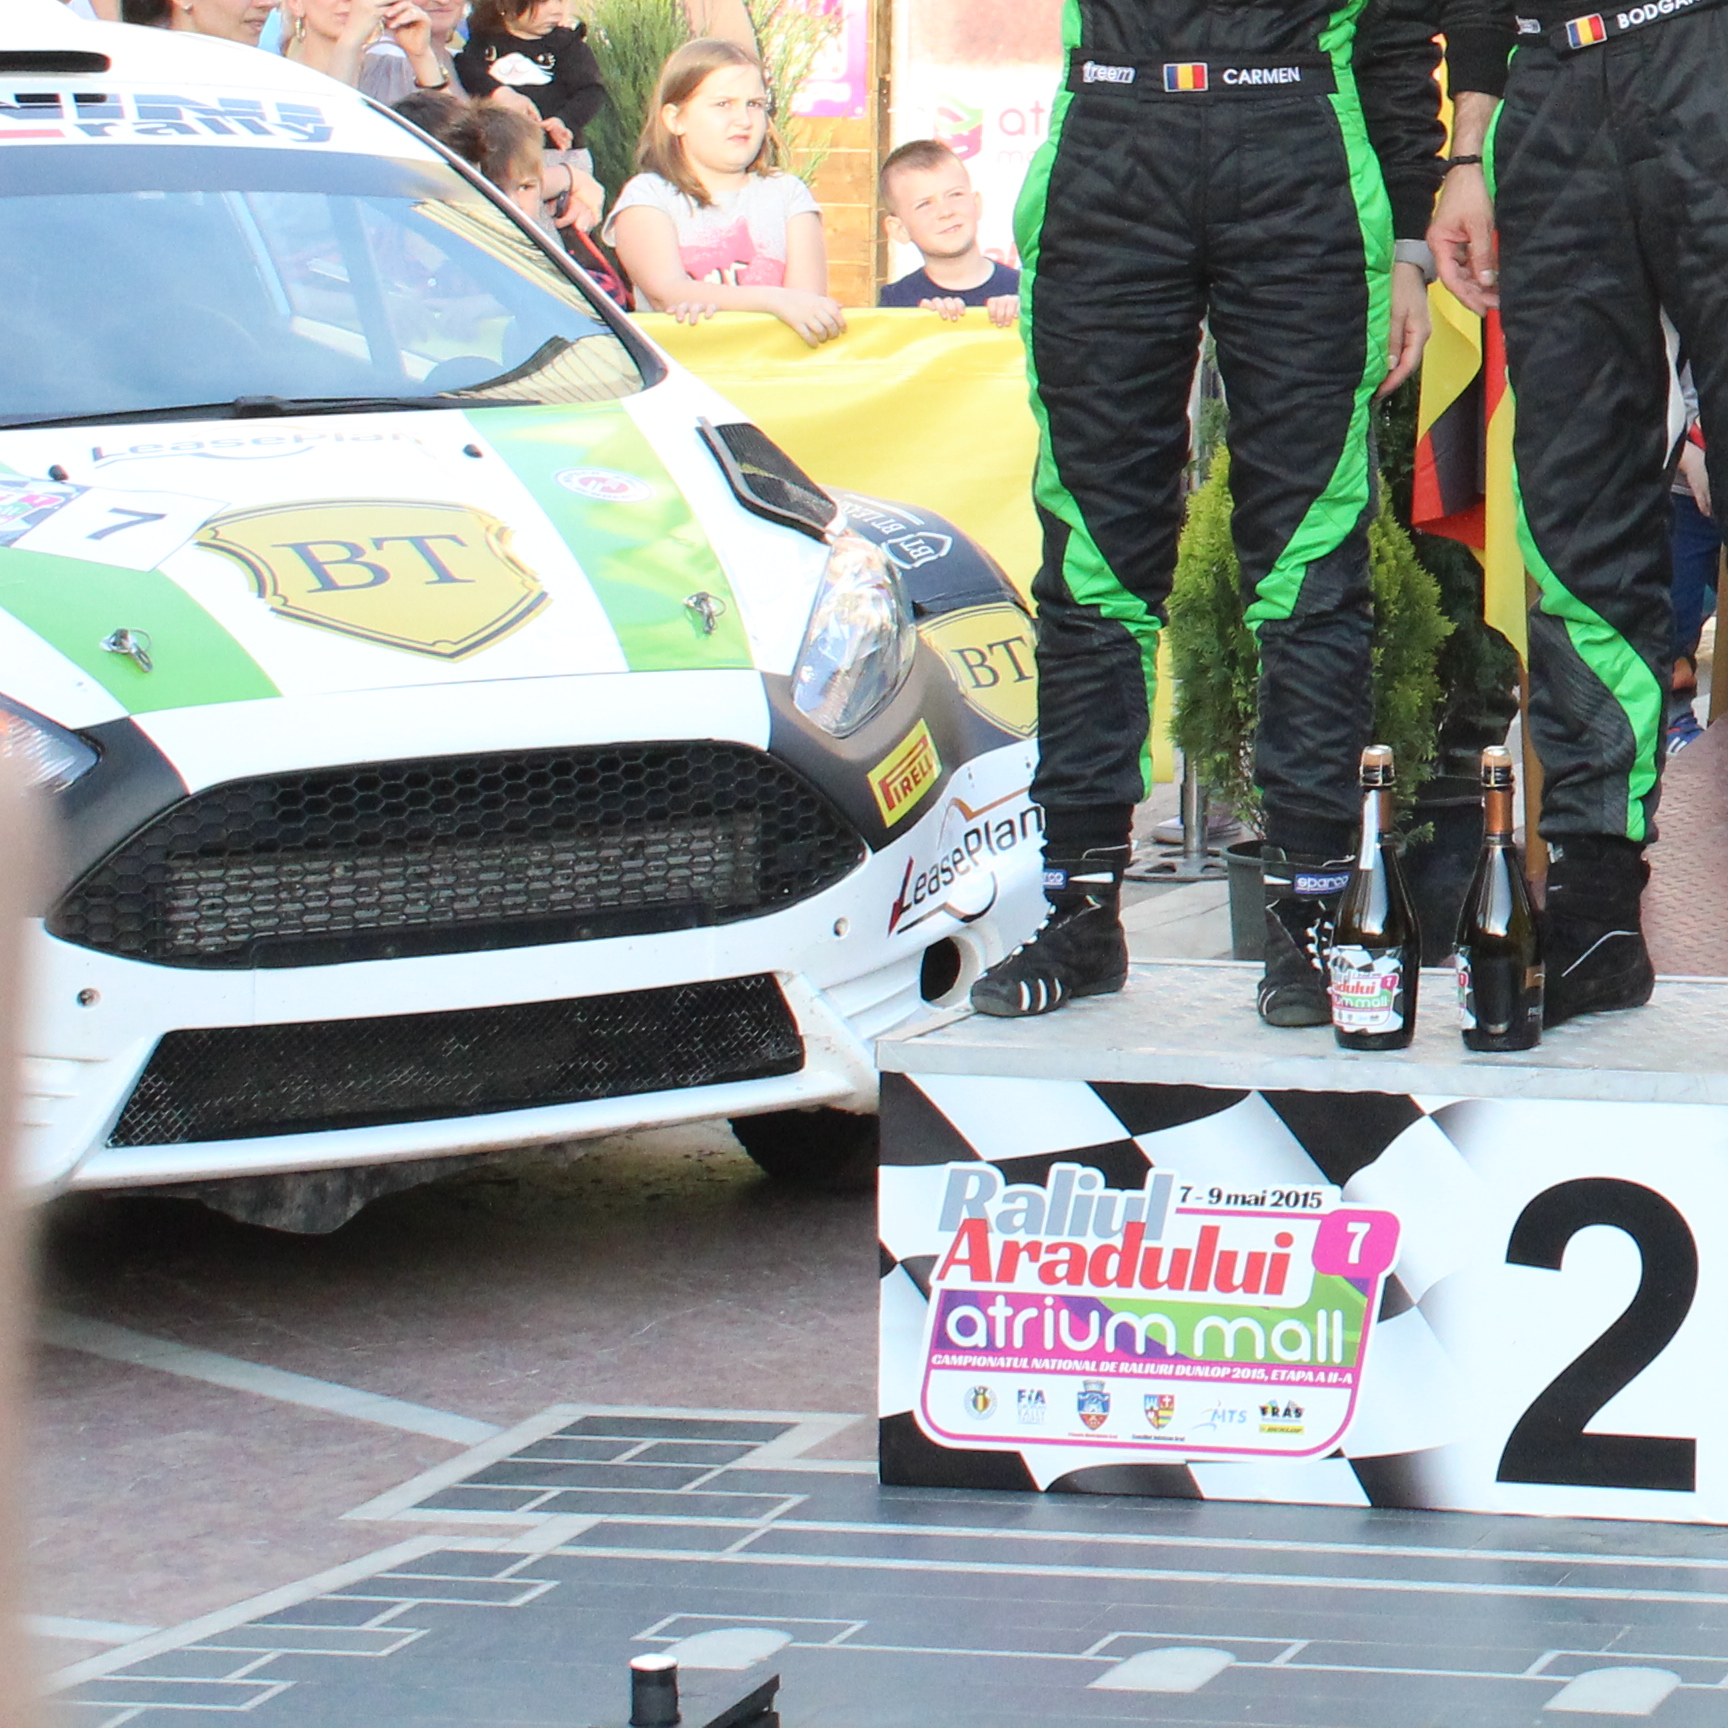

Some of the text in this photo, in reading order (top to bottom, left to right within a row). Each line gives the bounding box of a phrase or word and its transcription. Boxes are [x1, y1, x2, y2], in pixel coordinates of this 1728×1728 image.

[1222, 65, 1301, 88] CARMEN
[91, 426, 423, 464] LeasePlan
[86, 506, 169, 542] 7
[271, 533, 477, 595] BT
[951, 635, 1037, 691] BT
[888, 803, 1047, 939] LeasePlan
[1299, 874, 1349, 891] sparco
[938, 1168, 1175, 1241] Raliul
[1179, 1185, 1324, 1210] 7 9 mai 2015
[936, 1217, 1295, 1297] Aradului
[1346, 1221, 1372, 1265] 7
[945, 1295, 1344, 1364] atrium mall
[1496, 1174, 1700, 1493] 2
[931, 1353, 1354, 1385] CAMPIONATUL NATIONAL DE RALIURI DUNLOP 2015, ETAPA II-A
